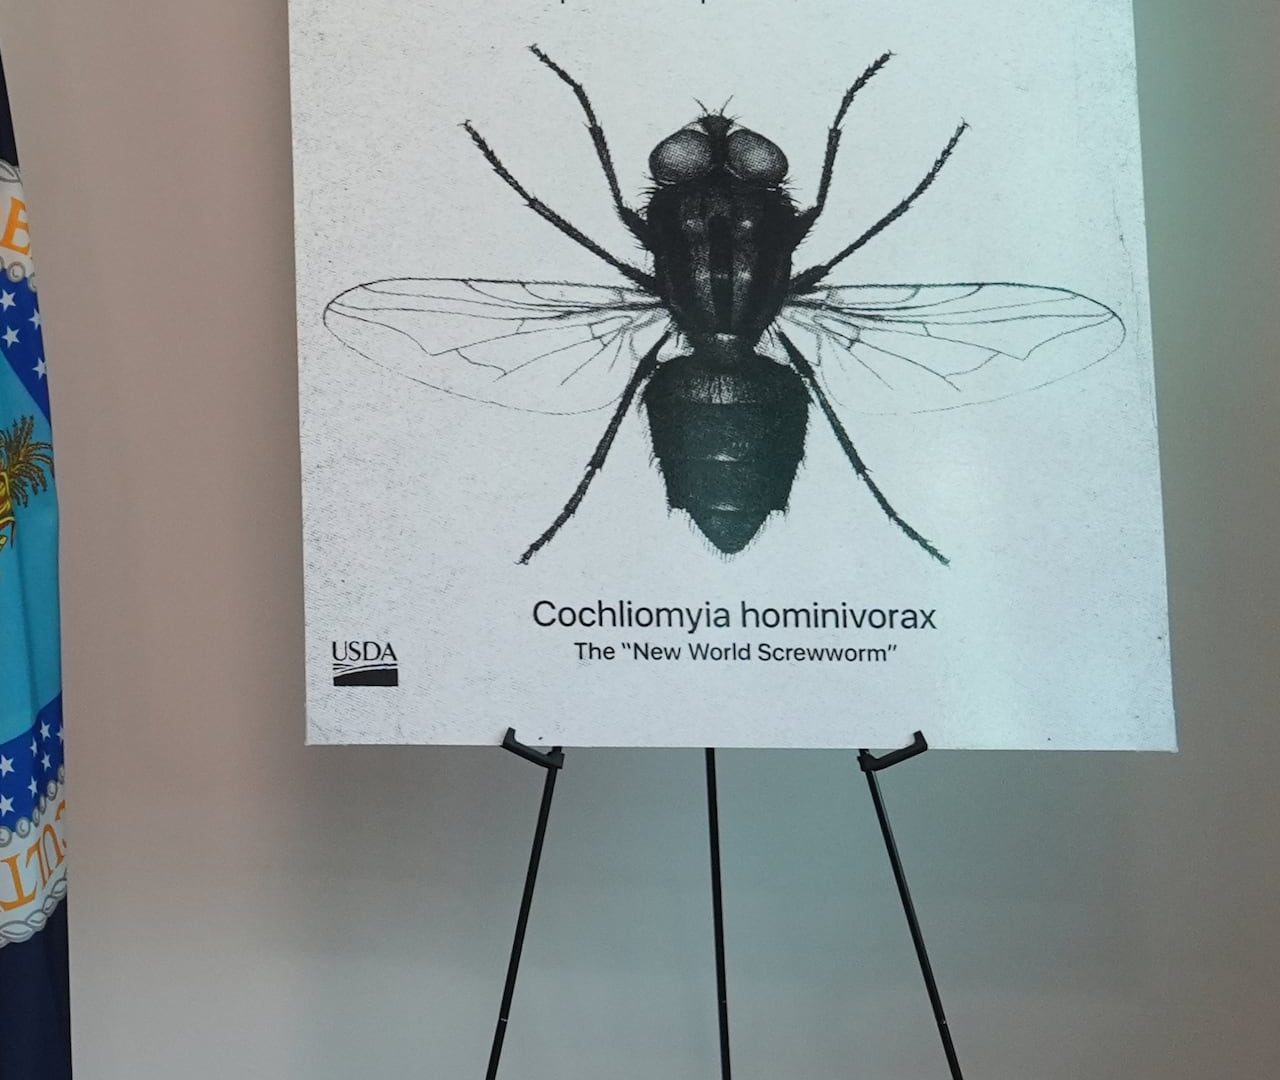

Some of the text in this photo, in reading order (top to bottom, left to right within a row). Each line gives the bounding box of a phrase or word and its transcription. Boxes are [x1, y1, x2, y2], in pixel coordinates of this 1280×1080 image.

[532, 599, 938, 635] Cochliomyia hominivorax
[332, 640, 398, 662] USDA
[573, 641, 897, 662] The “New World Screwworm”
